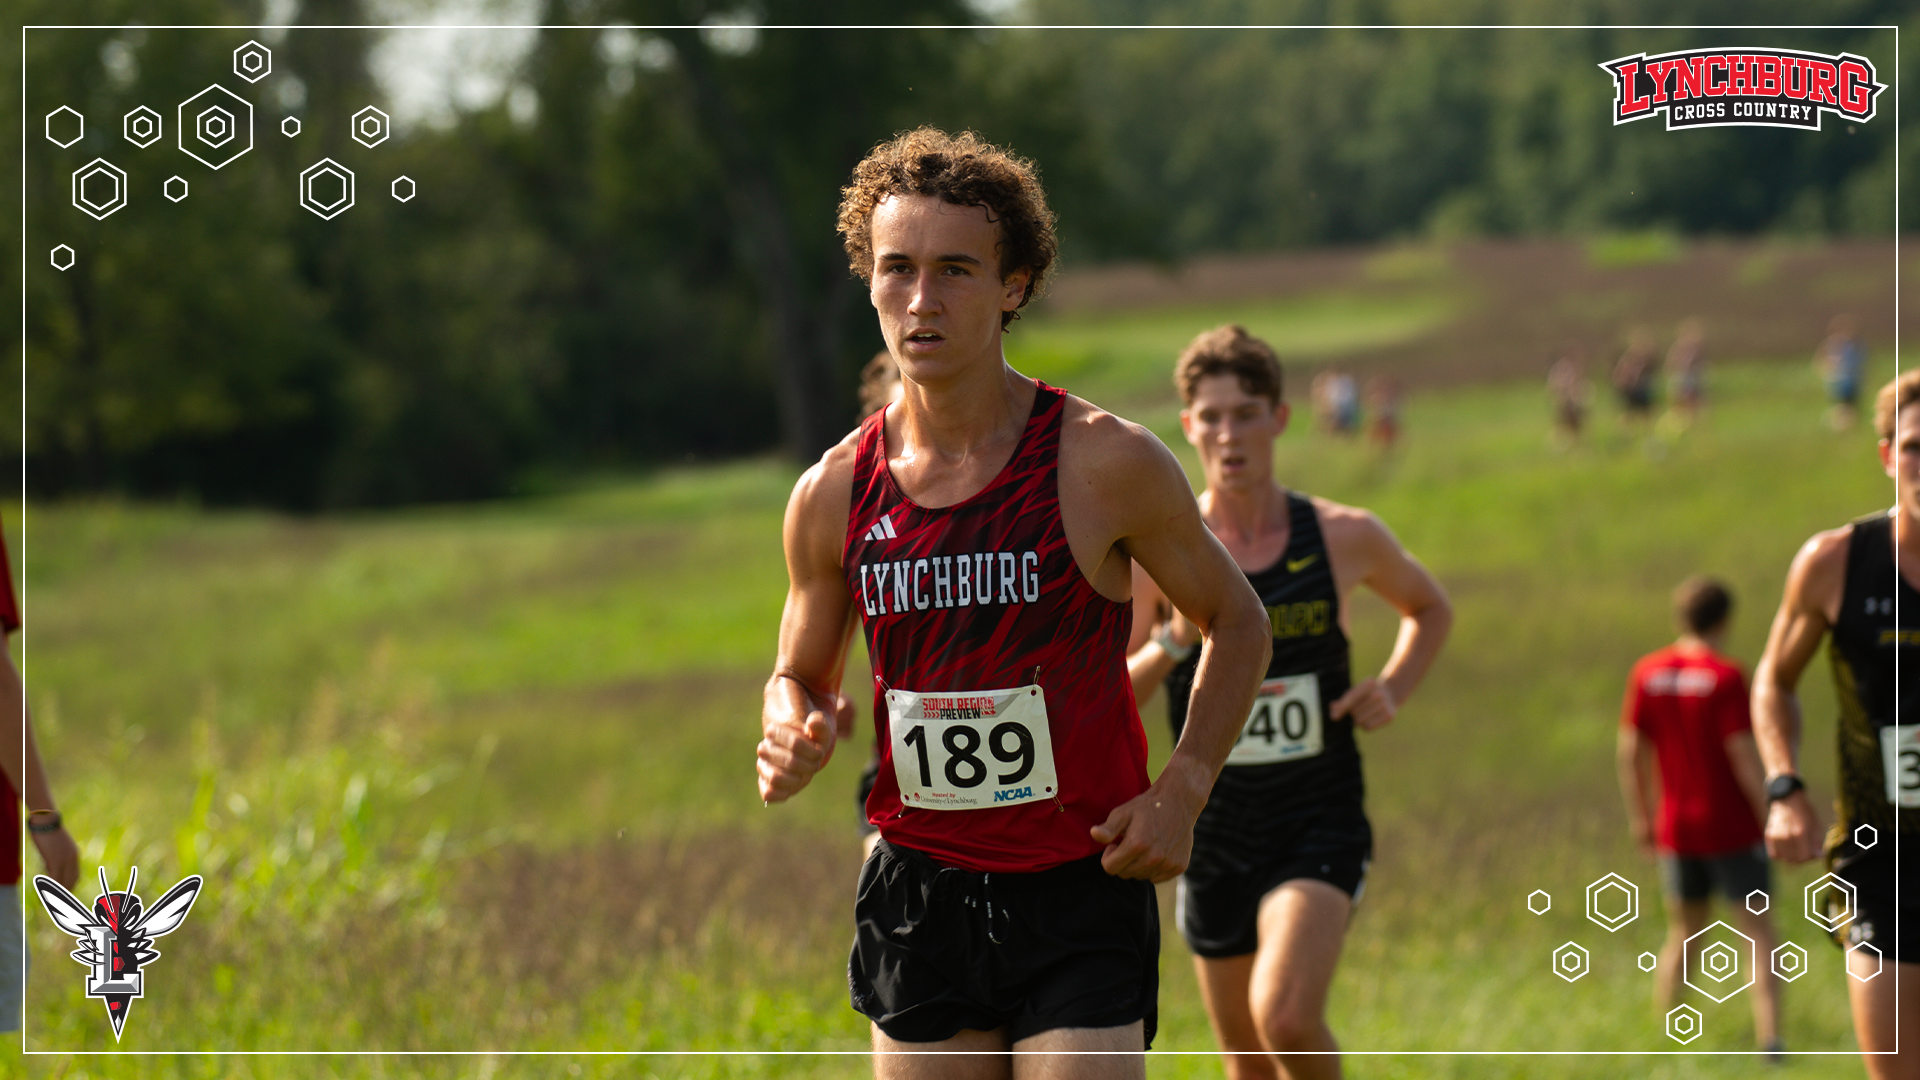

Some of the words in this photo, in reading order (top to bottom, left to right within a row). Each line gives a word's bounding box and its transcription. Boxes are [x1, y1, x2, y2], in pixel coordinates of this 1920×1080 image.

[860, 551, 1040, 617] LYNCHBURG
[922, 697, 954, 711] SOUTH
[956, 696, 995, 711] REGION
[940, 708, 981, 720] PREVIEW
[1235, 701, 1308, 745] 40
[903, 721, 1036, 789] 189
[993, 786, 1033, 803] NCAA
